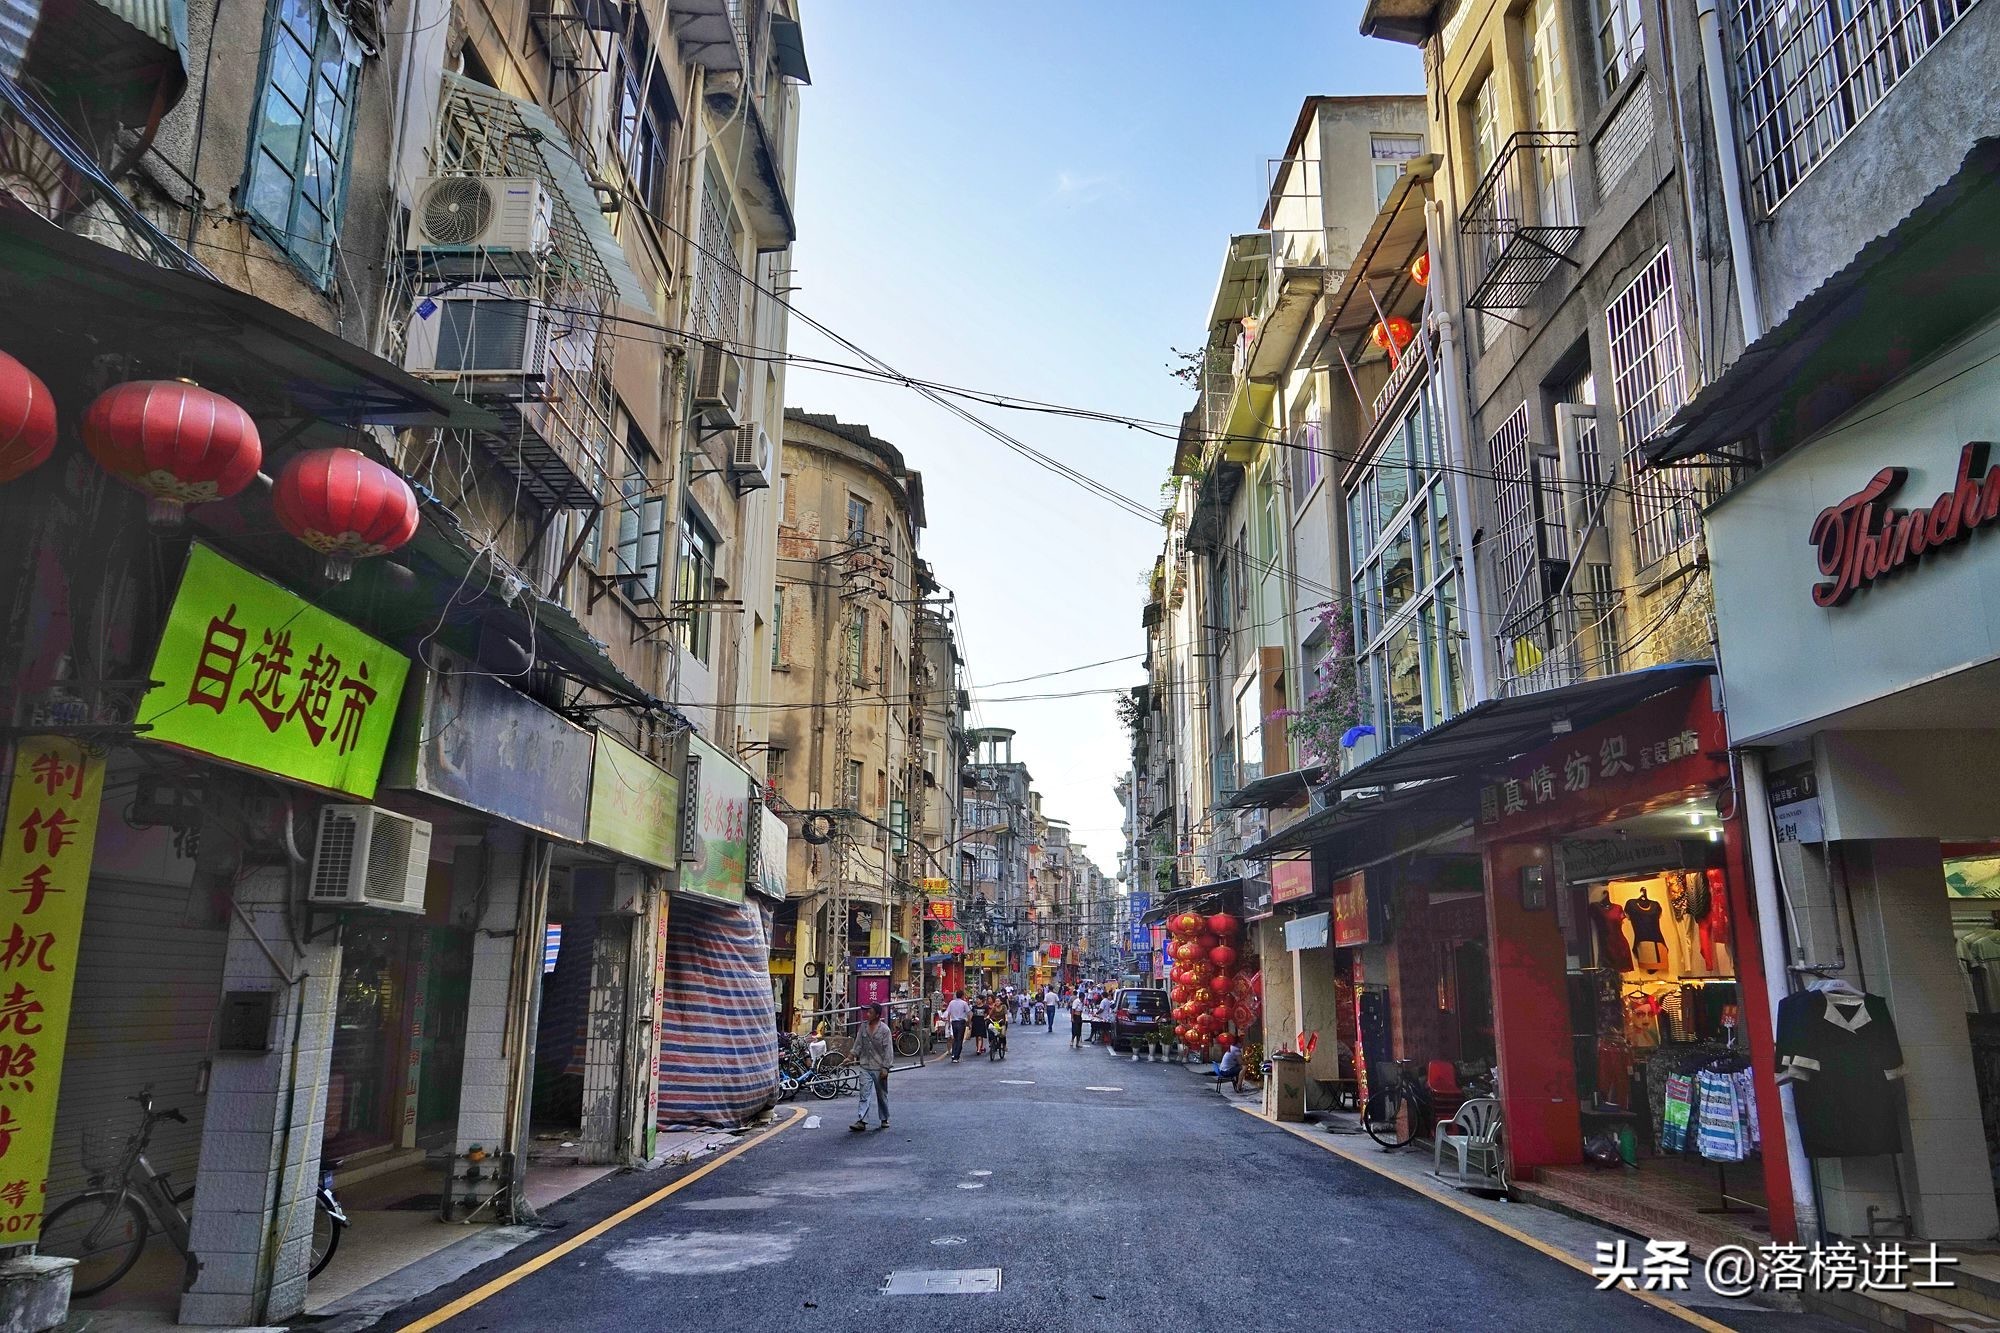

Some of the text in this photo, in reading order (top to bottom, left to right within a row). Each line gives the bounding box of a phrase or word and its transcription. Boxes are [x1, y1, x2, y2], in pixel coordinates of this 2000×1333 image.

[188, 603, 378, 757] 自选超市
[1503, 735, 1635, 817] 真情纺织
